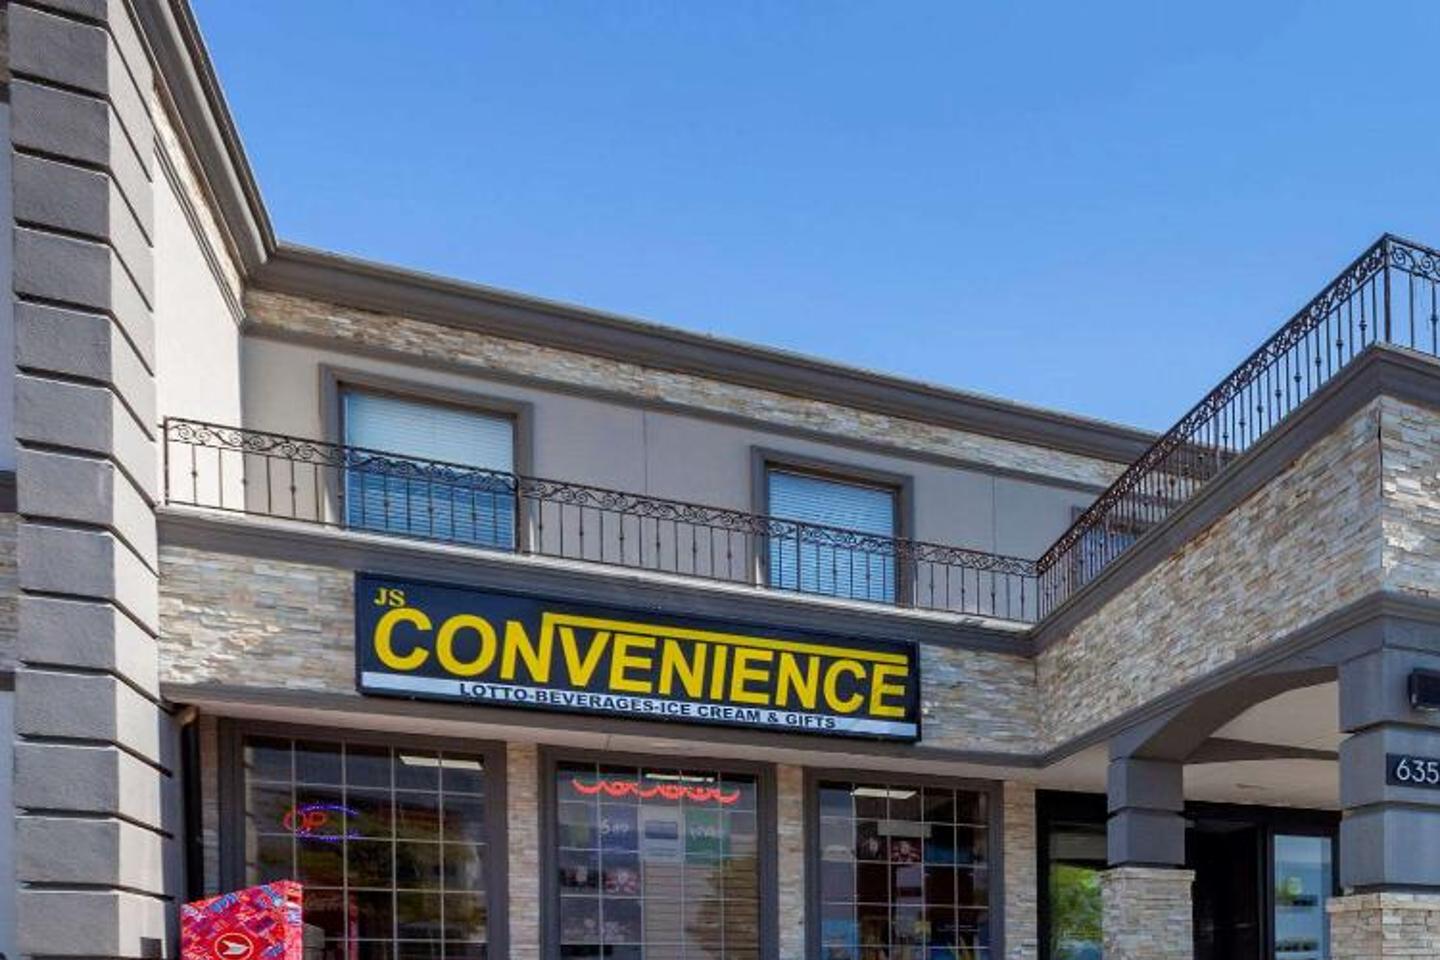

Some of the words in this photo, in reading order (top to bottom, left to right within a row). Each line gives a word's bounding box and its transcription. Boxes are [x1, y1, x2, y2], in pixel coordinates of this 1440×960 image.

[374, 587, 406, 607] JS
[373, 607, 909, 718] CONVENIENCE
[697, 706, 761, 723] CREAM
[767, 711, 779, 724] &
[786, 713, 836, 730] GIFTS
